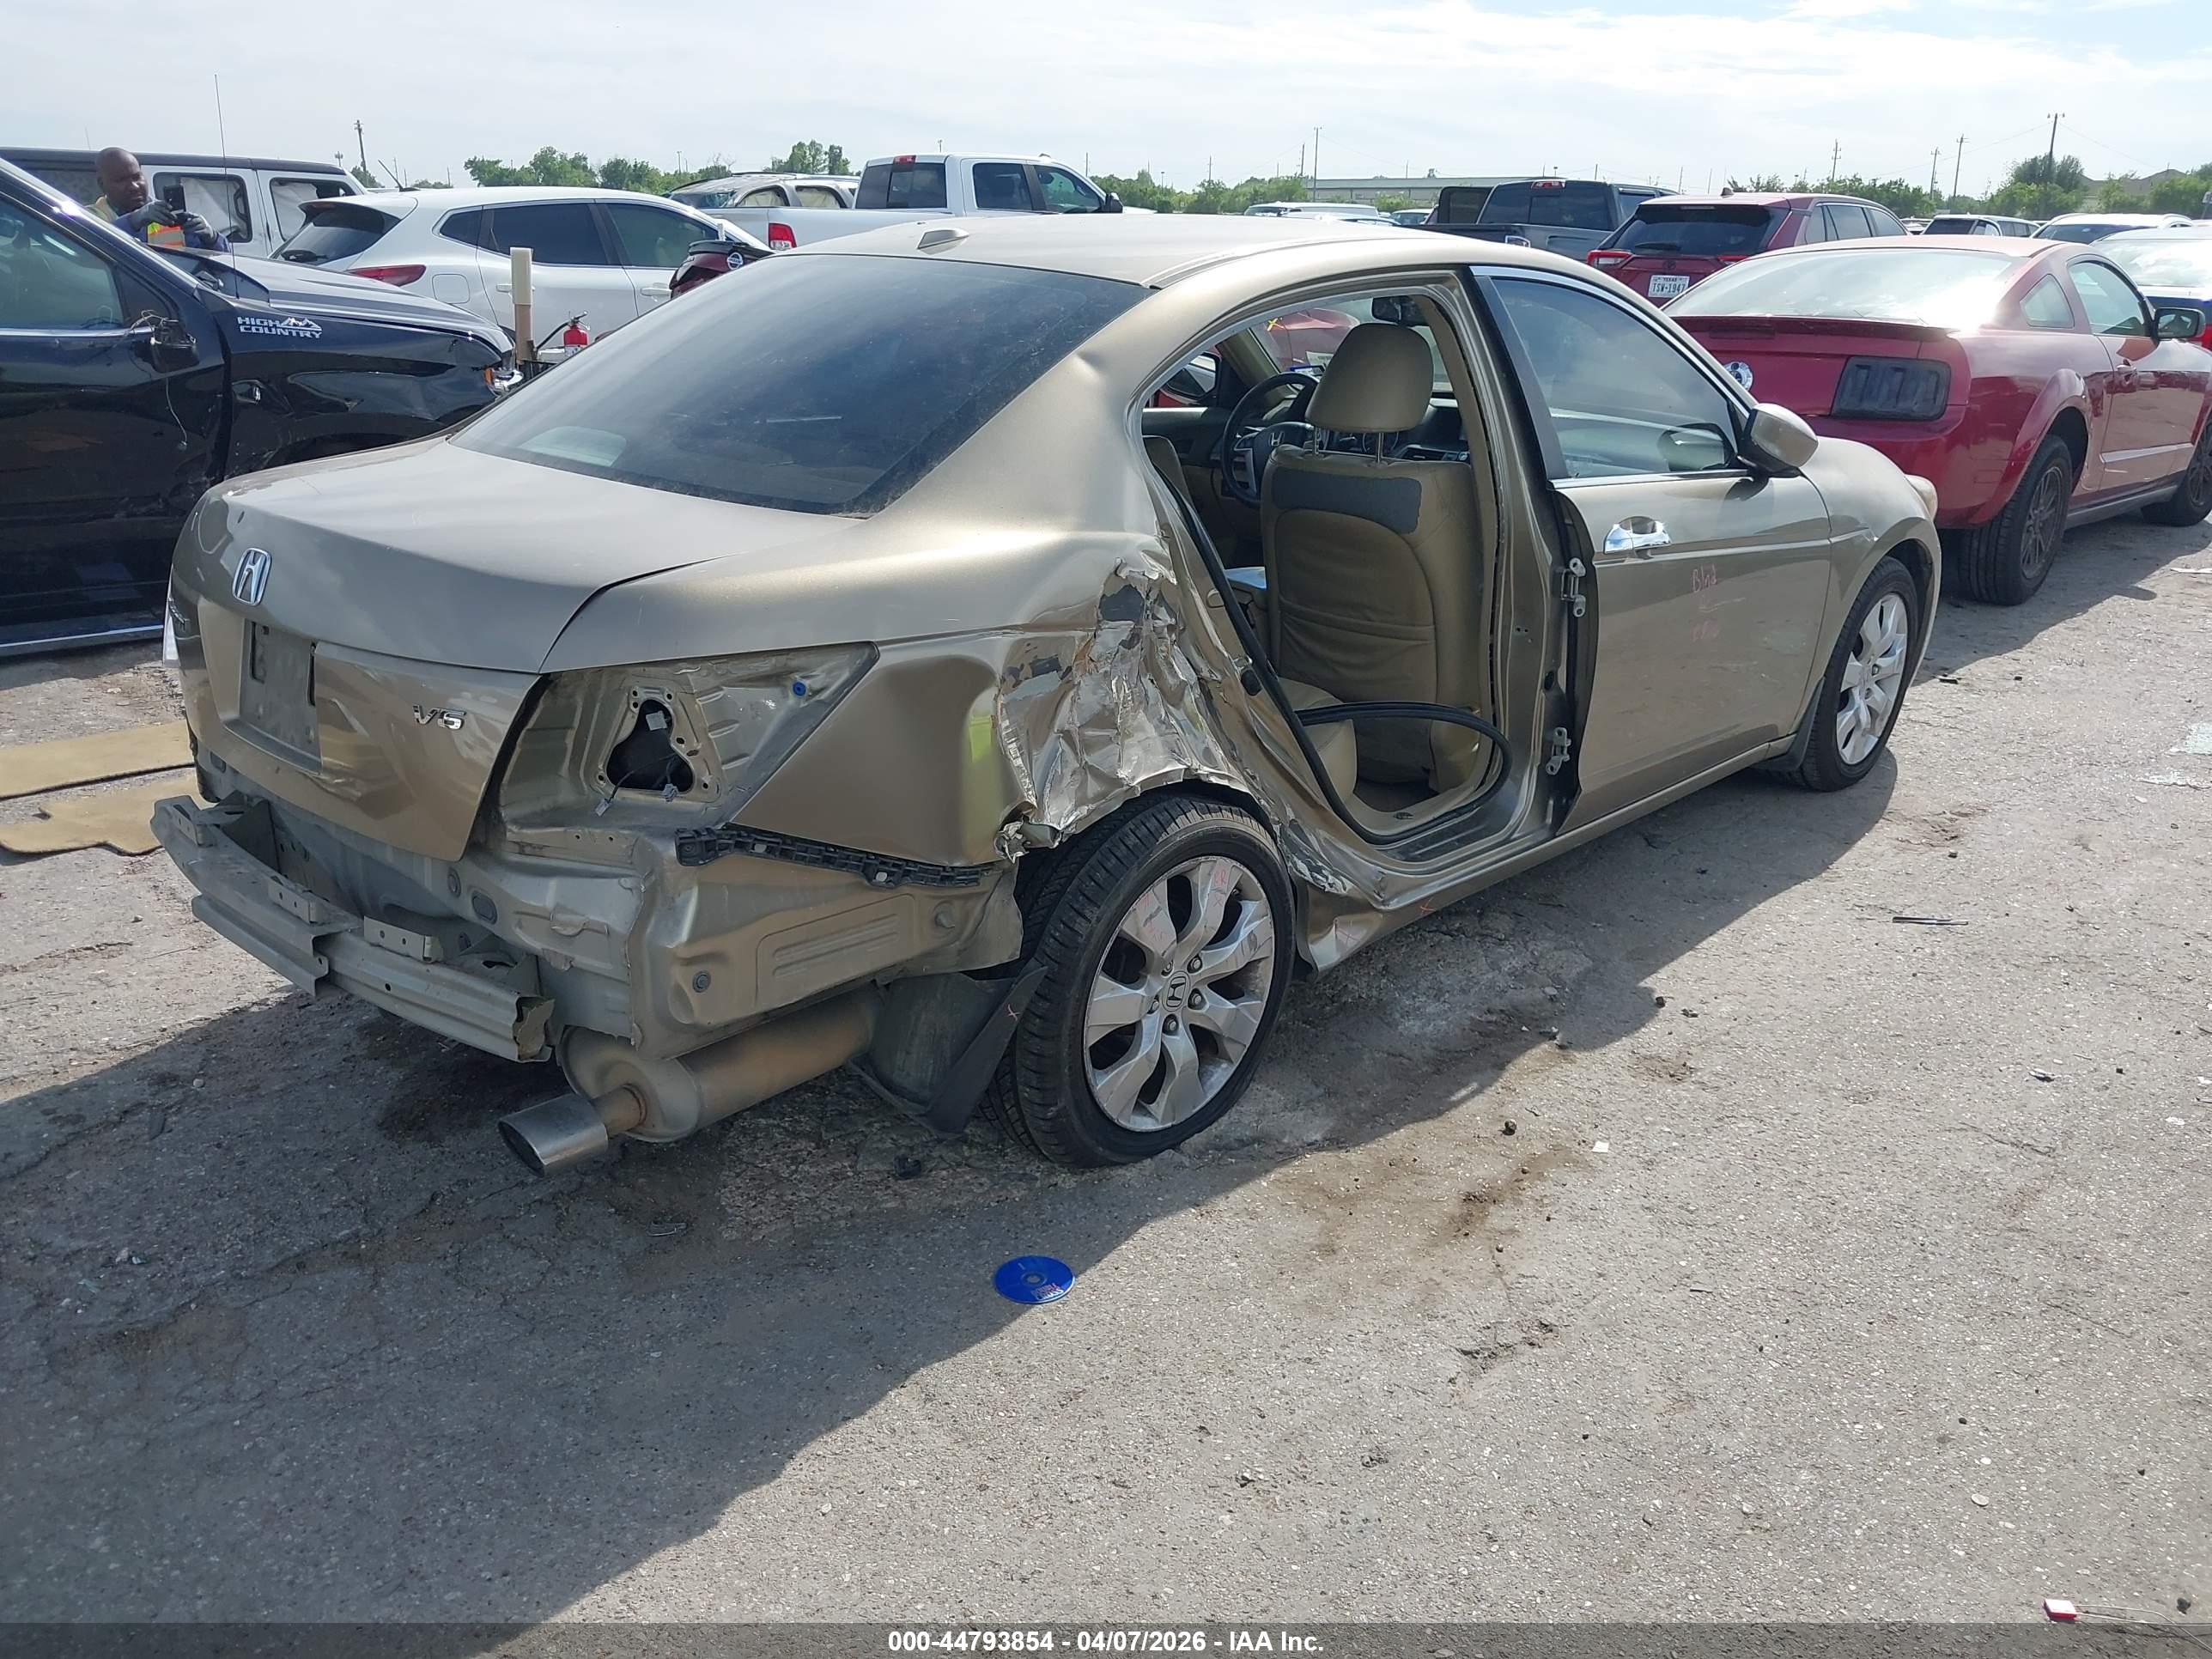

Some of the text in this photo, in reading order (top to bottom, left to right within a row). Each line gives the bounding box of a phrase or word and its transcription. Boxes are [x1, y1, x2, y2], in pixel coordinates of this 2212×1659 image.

[237, 317, 282, 327] HIGH
[240, 325, 322, 338] COUNTRY
[412, 704, 467, 731] V6
